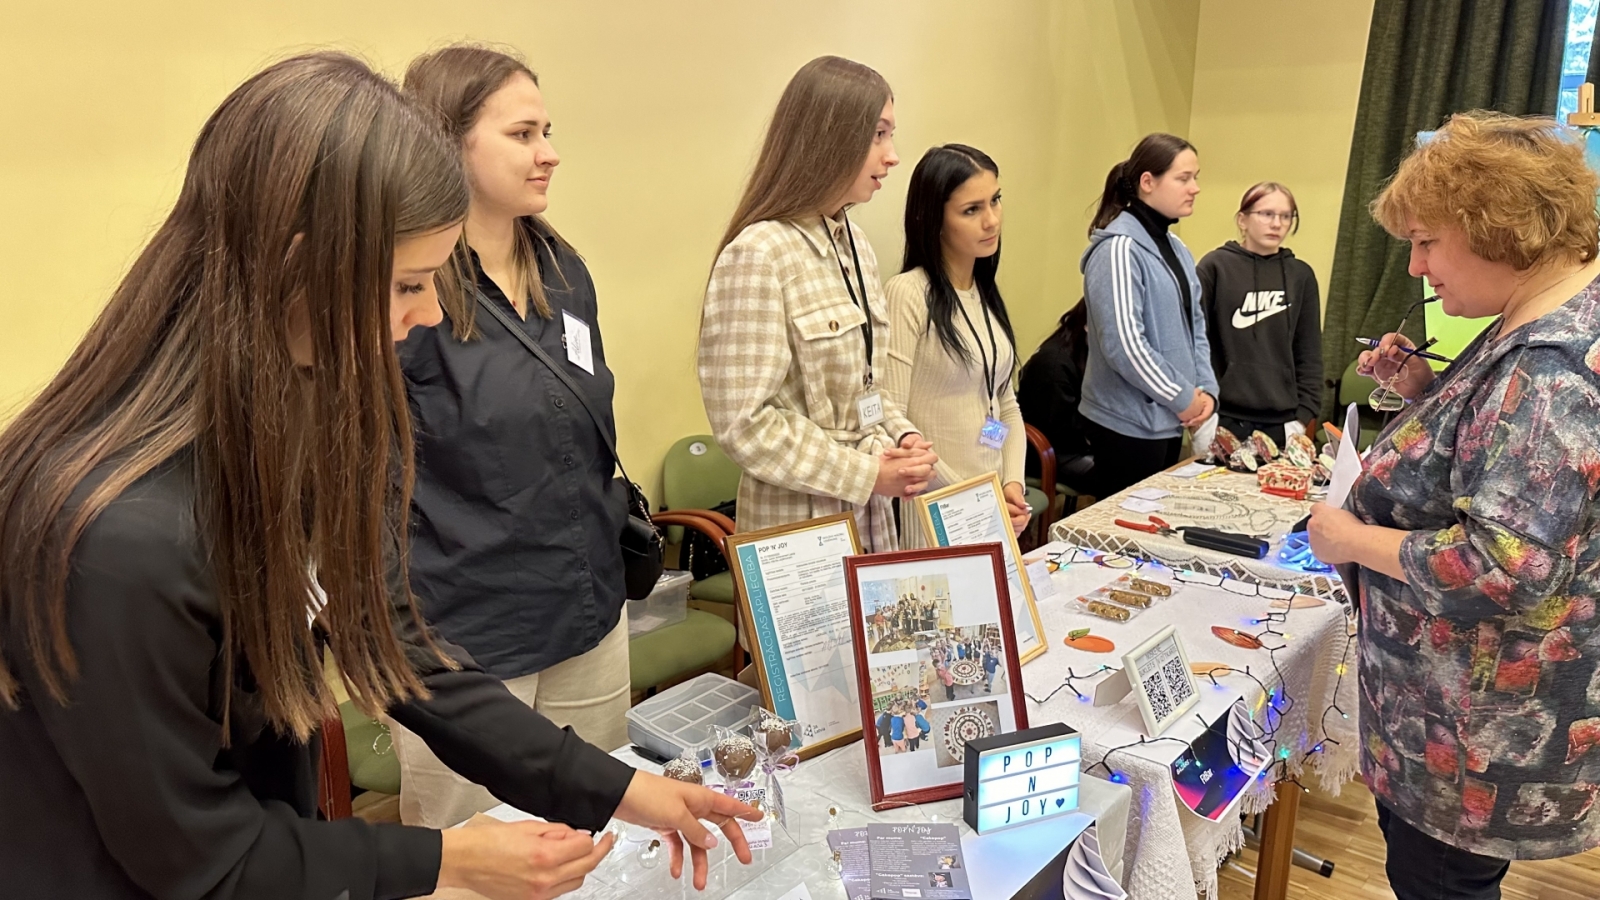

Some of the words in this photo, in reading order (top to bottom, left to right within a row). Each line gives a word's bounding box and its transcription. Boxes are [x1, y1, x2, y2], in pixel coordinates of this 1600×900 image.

[1241, 290, 1285, 312] NIKE
[862, 403, 881, 419] KEITA
[1004, 747, 1052, 773] POP
[1028, 776, 1036, 793] N
[1005, 798, 1047, 824] JOY
